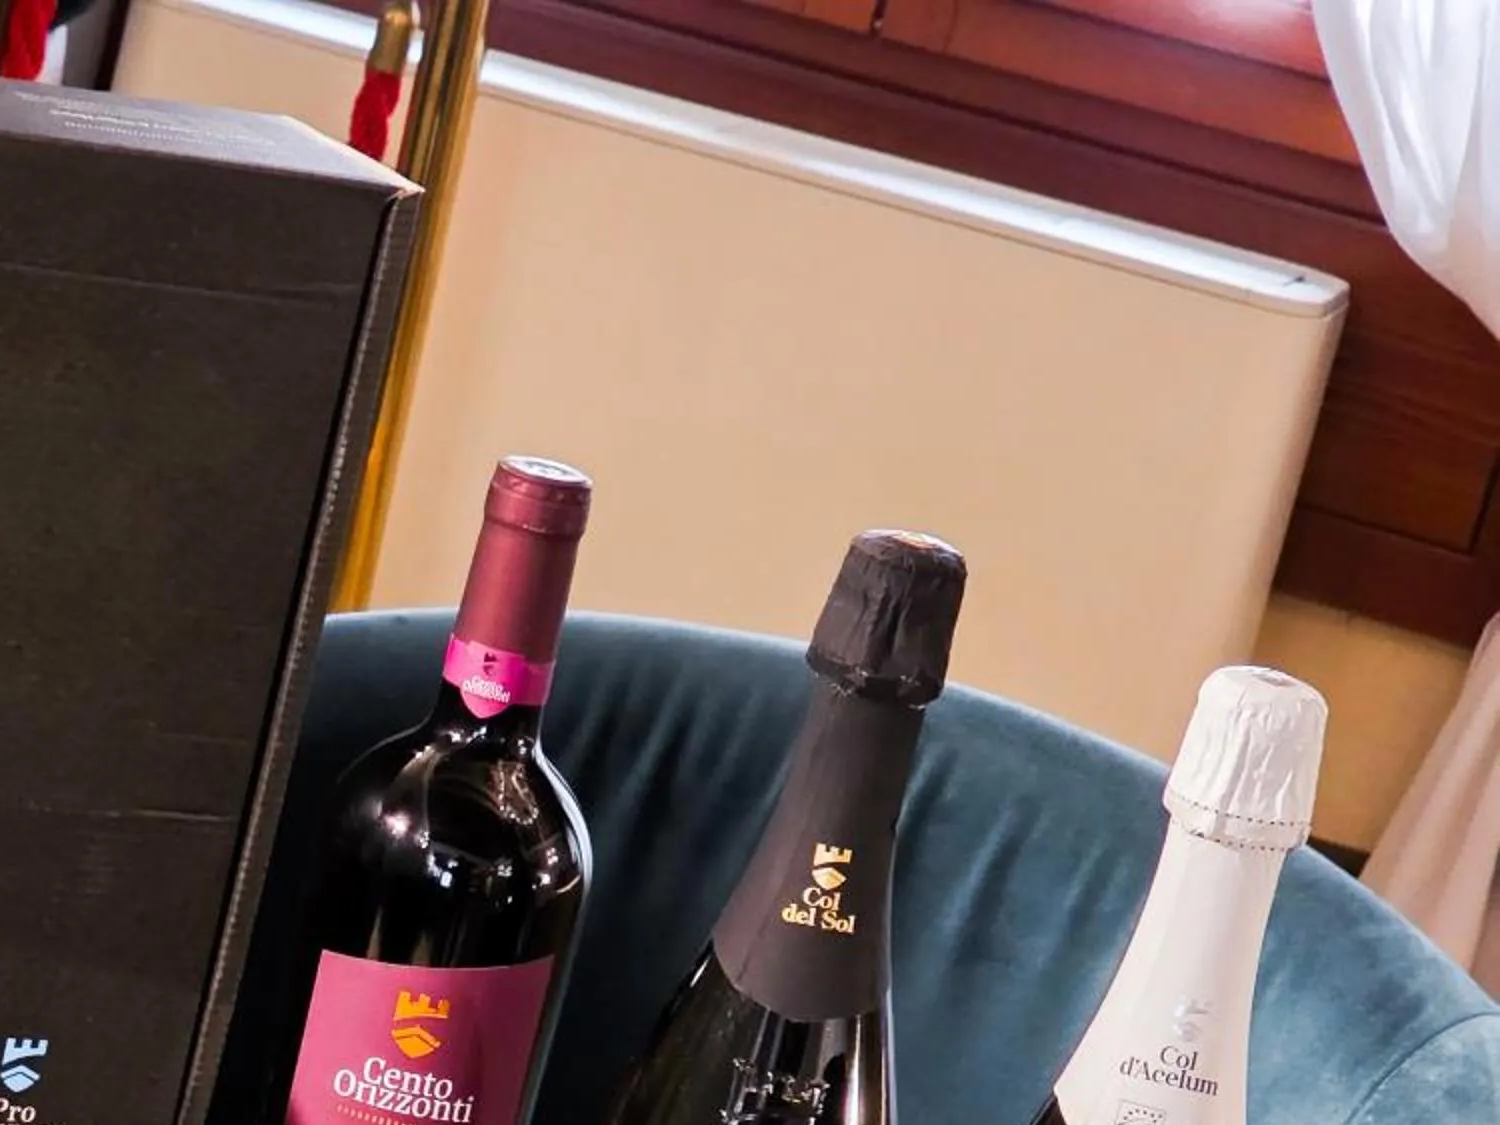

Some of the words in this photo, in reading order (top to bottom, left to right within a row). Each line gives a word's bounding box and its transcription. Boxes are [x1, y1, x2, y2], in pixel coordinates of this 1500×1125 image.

[803, 887, 841, 911] Col
[781, 903, 817, 927] del
[821, 910, 856, 935] Sol
[1119, 1056, 1220, 1096] d'Acelum
[1159, 1045, 1199, 1071] Col
[333, 1068, 475, 1124] Orizzonti
[362, 1057, 453, 1101] Cento
